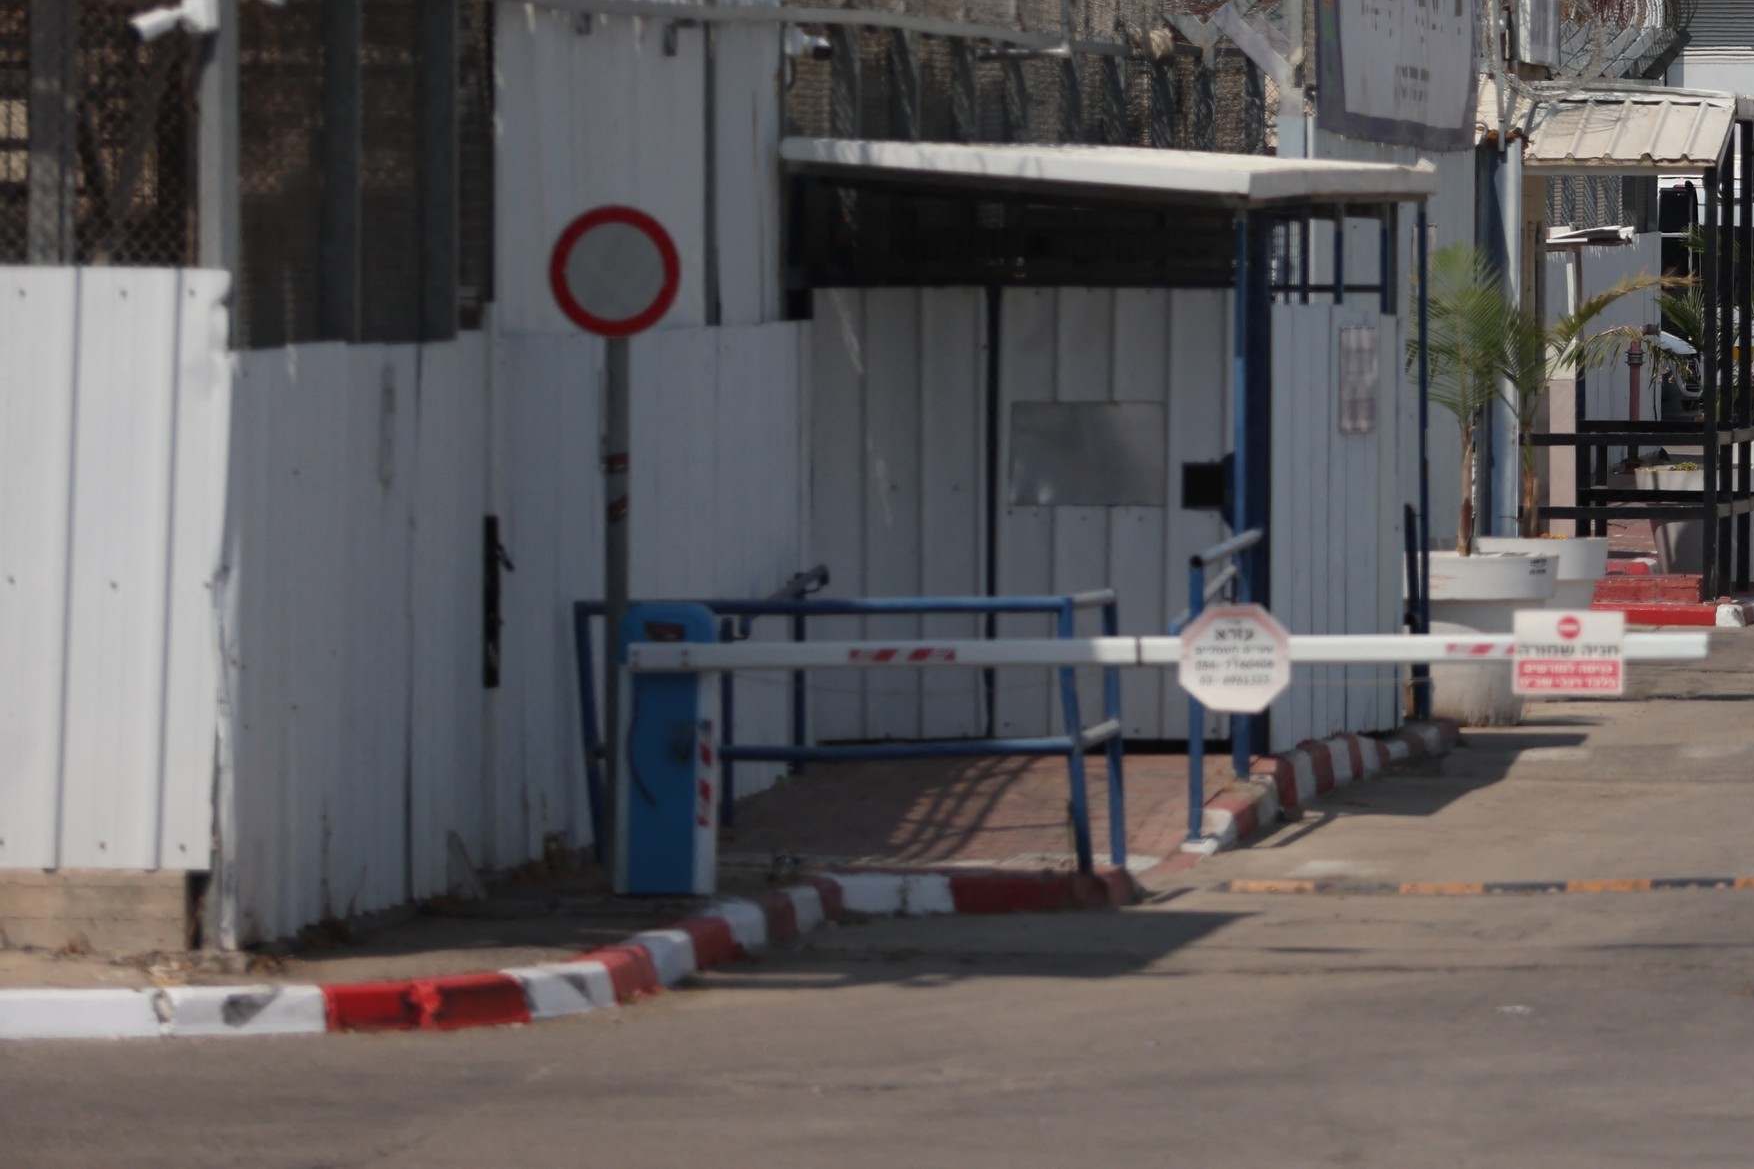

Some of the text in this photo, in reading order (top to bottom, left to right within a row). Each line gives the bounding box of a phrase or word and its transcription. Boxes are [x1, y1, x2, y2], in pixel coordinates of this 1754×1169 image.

[1214, 627, 1255, 642] עזרא
[1518, 643, 1619, 657] חניה שמורה
